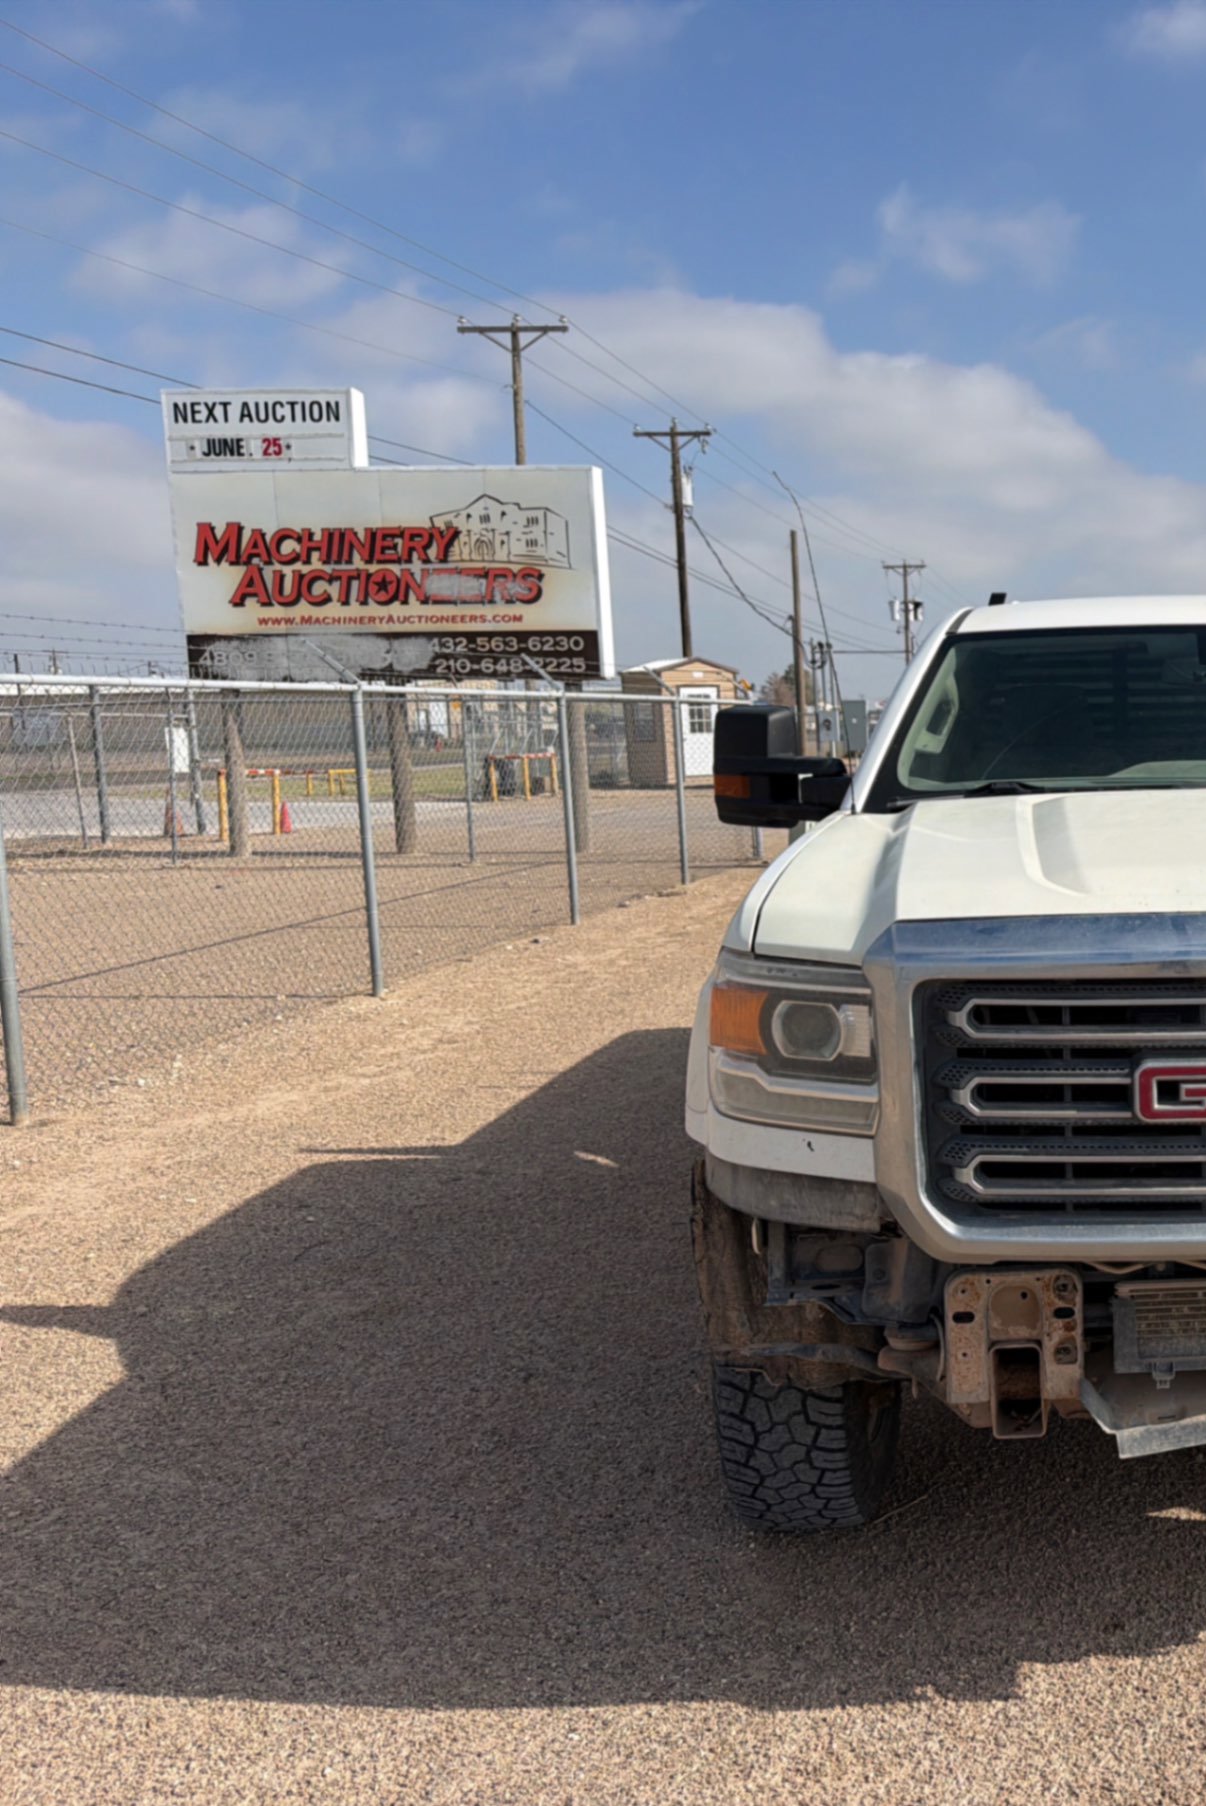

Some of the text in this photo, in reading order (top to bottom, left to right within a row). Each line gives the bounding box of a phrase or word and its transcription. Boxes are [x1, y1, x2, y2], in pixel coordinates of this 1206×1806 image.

[173, 400, 340, 424] NEXT AUCTION
[262, 437, 283, 457] 25
[429, 635, 585, 652] 432-563-6230
